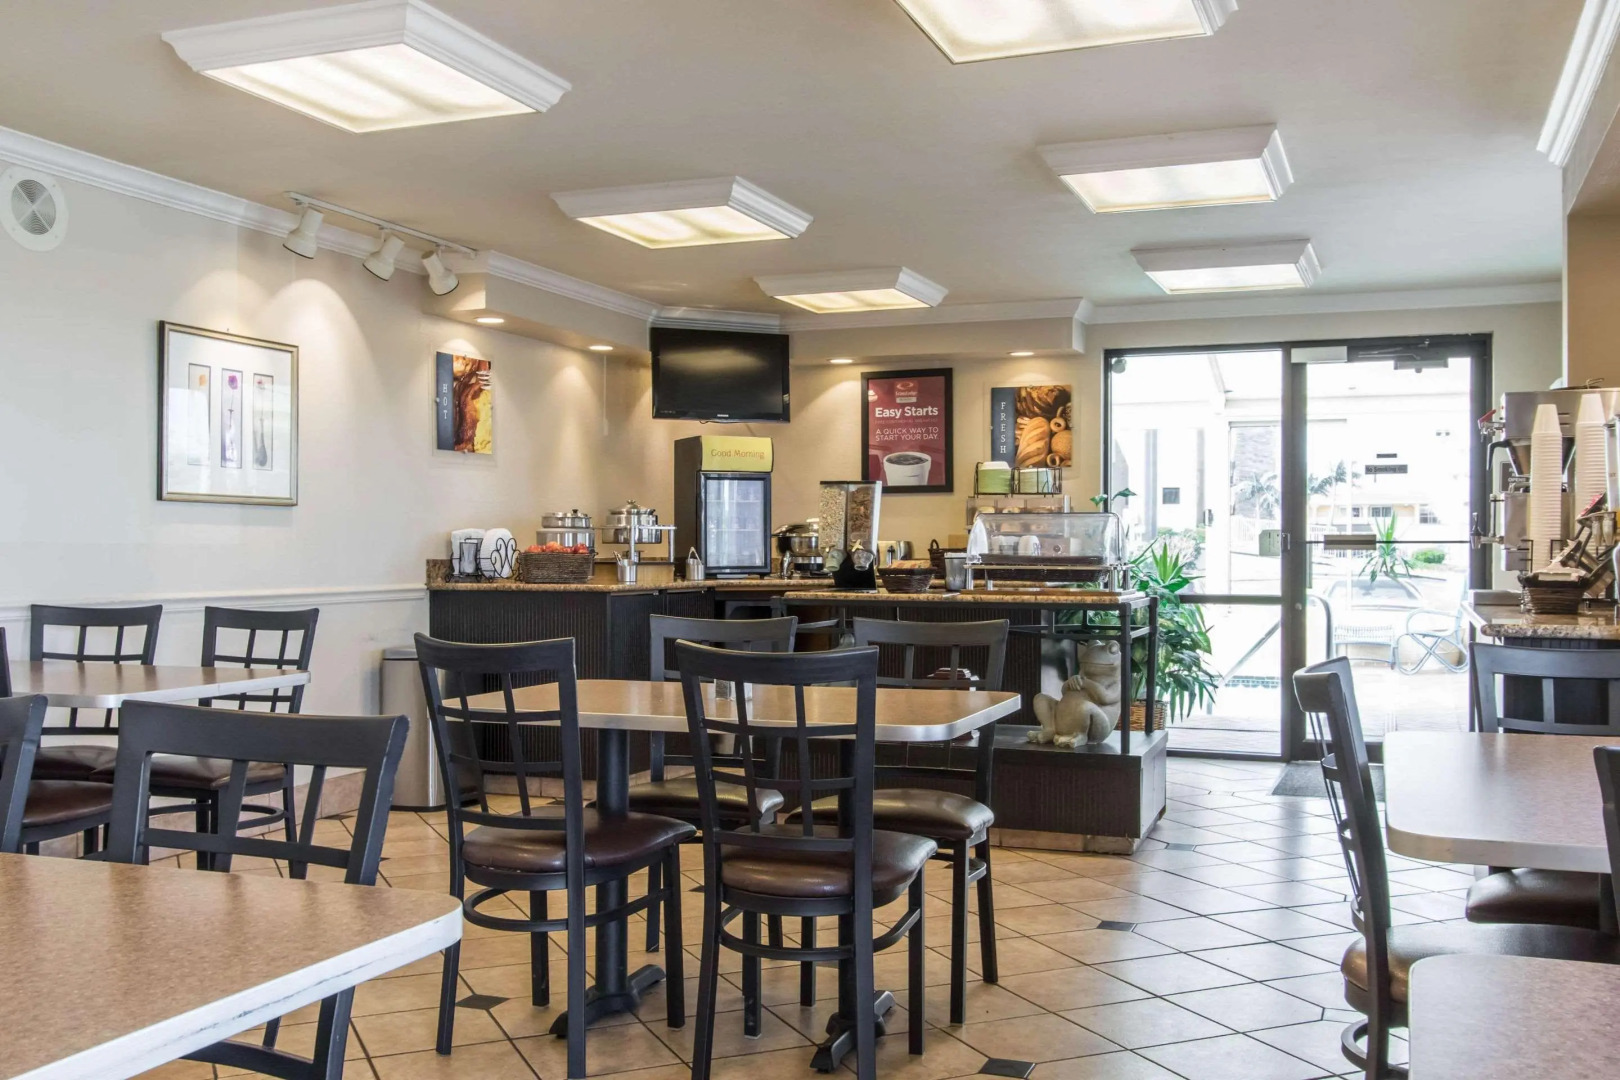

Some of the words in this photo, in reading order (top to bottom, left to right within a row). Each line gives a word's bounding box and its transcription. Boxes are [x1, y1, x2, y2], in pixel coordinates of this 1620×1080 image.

[875, 407, 902, 419] Easy
[904, 405, 939, 417] Starts
[875, 434, 899, 442] START
[900, 433, 922, 441] YOUR
[711, 449, 732, 457] Good
[734, 449, 765, 460] Morning
